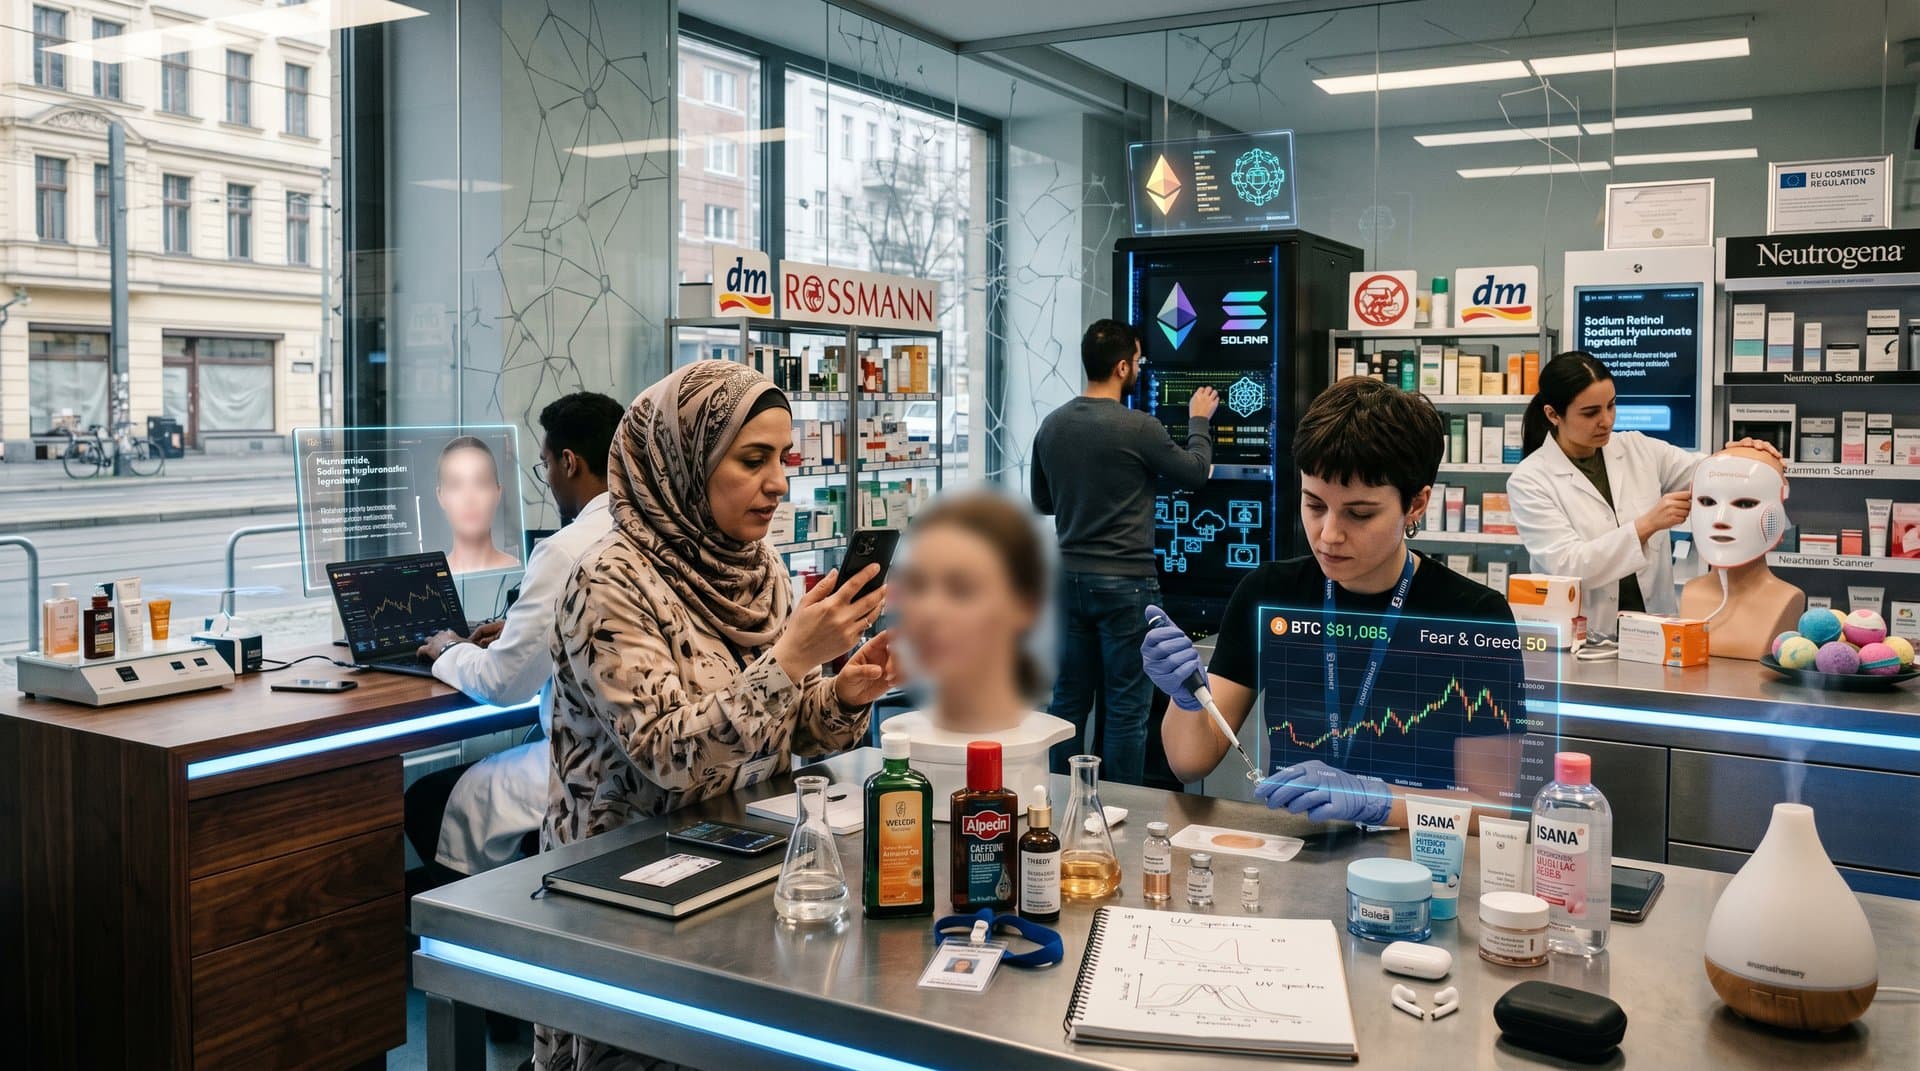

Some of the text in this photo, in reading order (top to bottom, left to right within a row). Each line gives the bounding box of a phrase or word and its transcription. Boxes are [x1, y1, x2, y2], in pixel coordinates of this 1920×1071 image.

[1810, 168, 1875, 179] EU COSMETICS
[1810, 178, 1866, 188] REGULATION
[1756, 241, 1903, 270] Neutrogena
[726, 256, 768, 295] dm
[1472, 275, 1527, 306] dm
[1584, 315, 1664, 326] Sodium Retinol
[1584, 326, 1692, 339] Sodium Hyaluronate
[1220, 335, 1268, 345] SOLANA
[1584, 337, 1637, 348] Ingredient
[1784, 373, 1875, 385] Neutrogena Scanner
[1833, 466, 1875, 476] Scanner
[1832, 558, 1875, 568] Scanner
[1291, 621, 1321, 636] BTC
[1420, 629, 1547, 652] Fear & Greed 50
[967, 818, 1007, 836] Alpecin
[1417, 814, 1455, 830] ISANA
[1536, 824, 1579, 846] ISANA
[1415, 845, 1446, 856] CREAM
[970, 852, 996, 863] LIQUID
[1361, 907, 1390, 921] Balea
[1170, 917, 1193, 925] UV
[1256, 980, 1274, 988] UV
